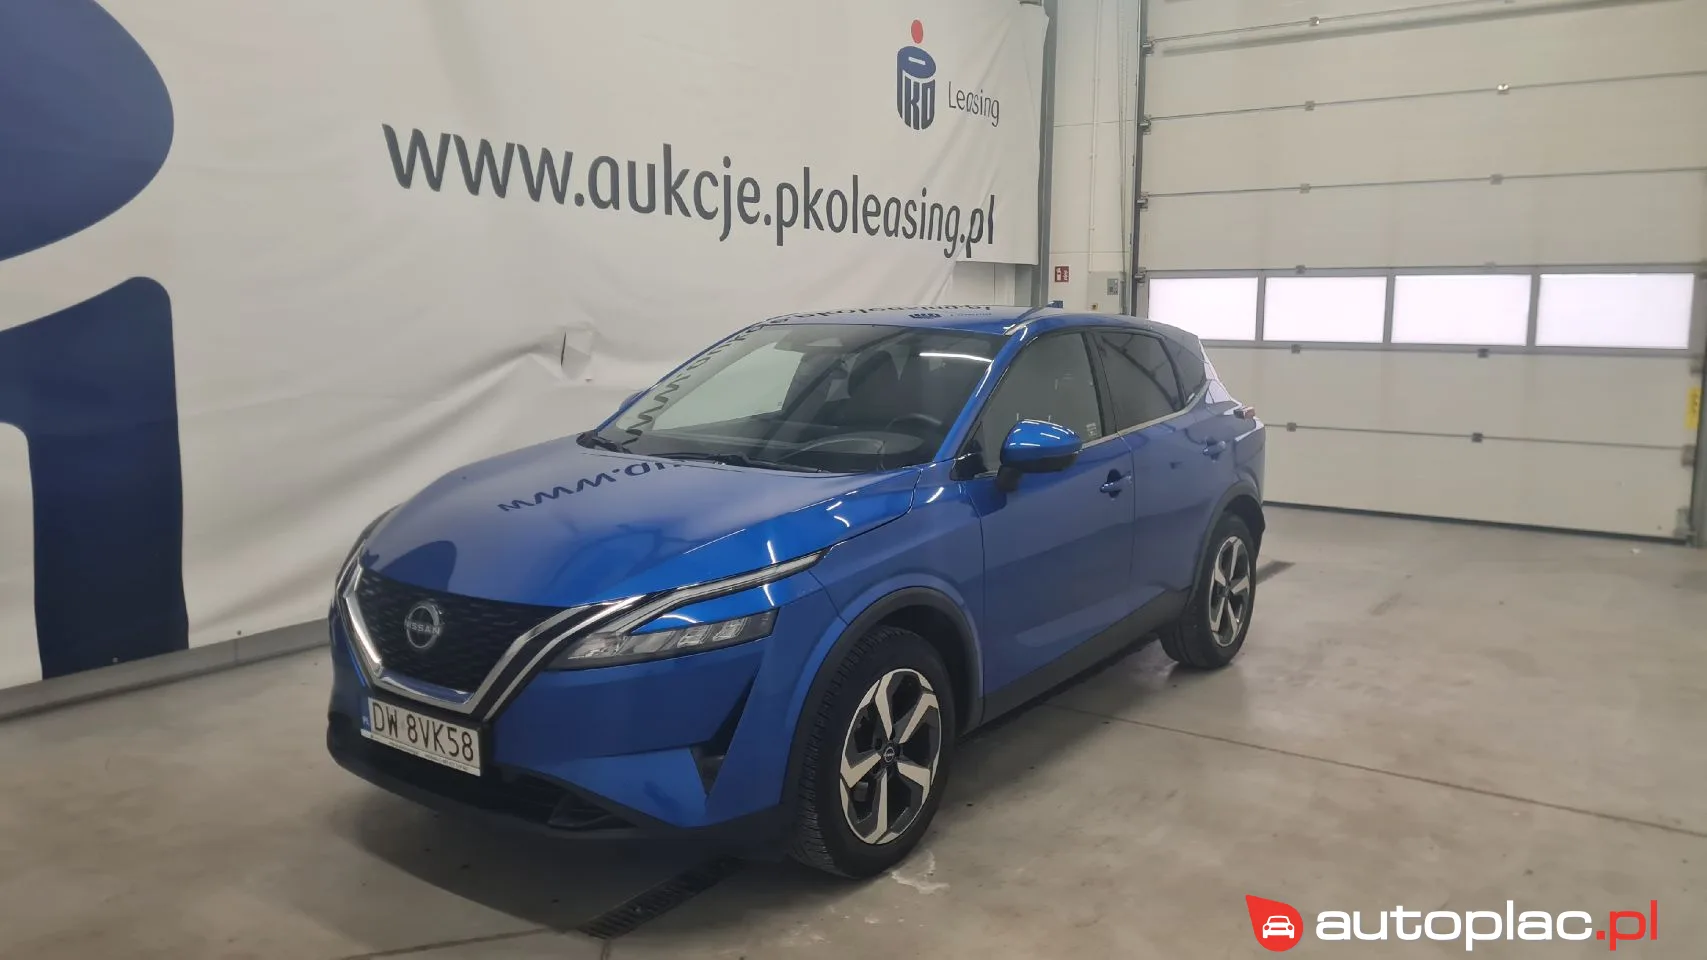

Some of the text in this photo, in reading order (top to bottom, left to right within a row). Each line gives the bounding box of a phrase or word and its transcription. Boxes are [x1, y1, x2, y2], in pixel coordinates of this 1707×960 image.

[949, 81, 999, 127] Leasing
[382, 124, 994, 258] www.aukcje.pkoleasing.pl
[405, 618, 441, 636] NISSAN
[373, 702, 398, 739] DW
[406, 714, 474, 761] 8VK58
